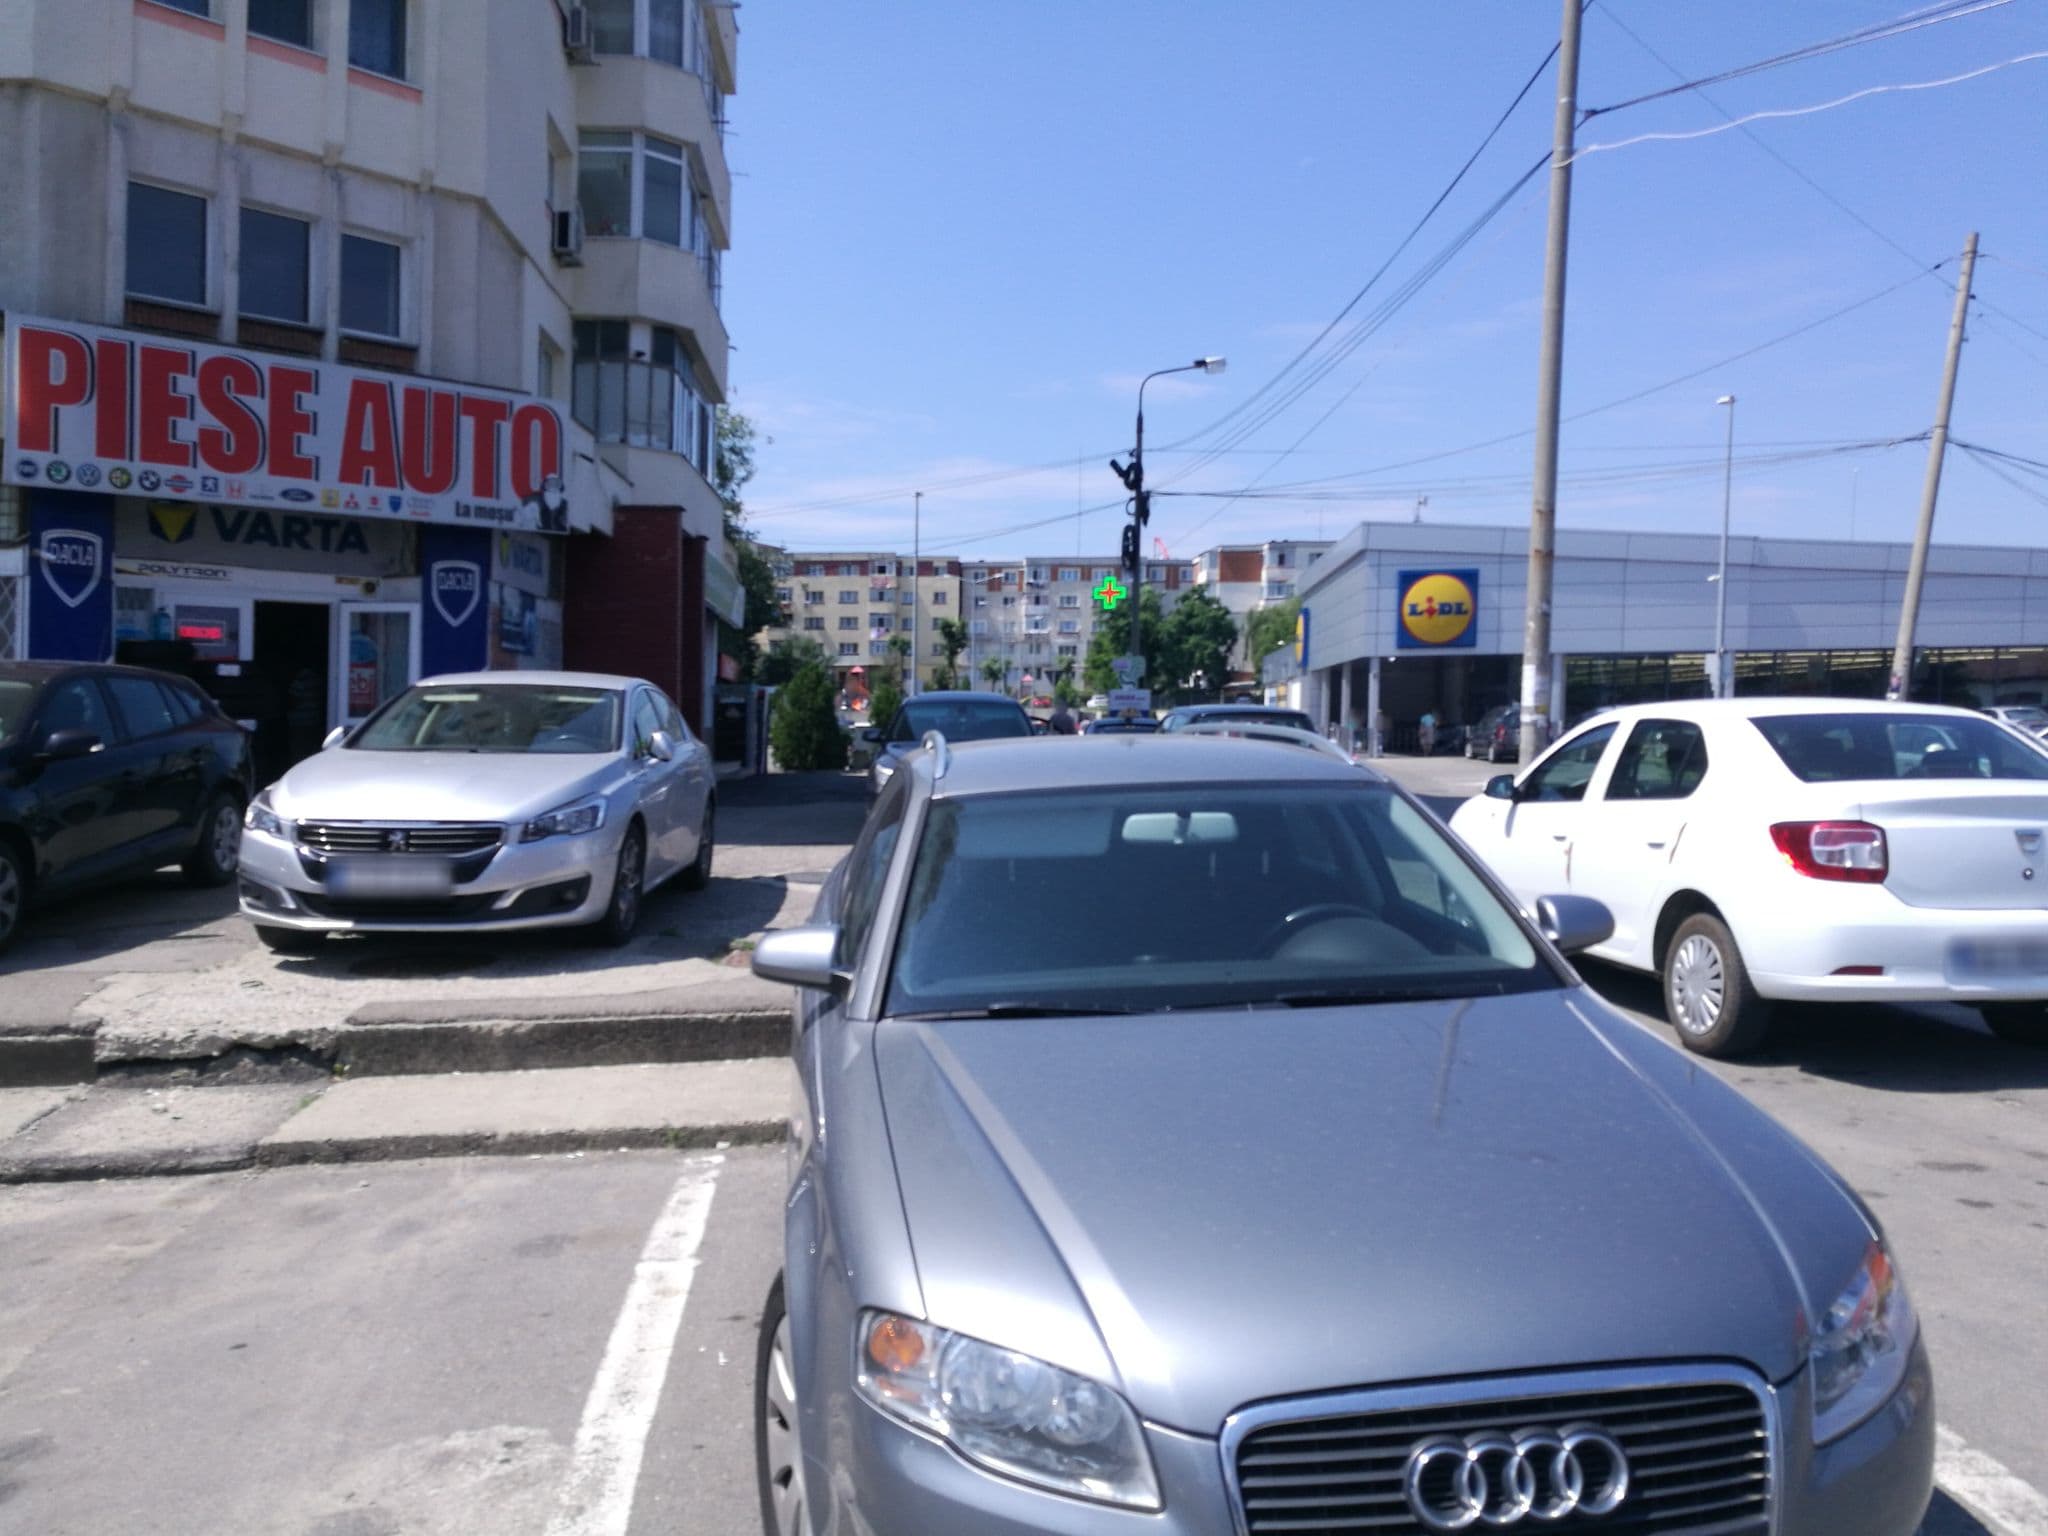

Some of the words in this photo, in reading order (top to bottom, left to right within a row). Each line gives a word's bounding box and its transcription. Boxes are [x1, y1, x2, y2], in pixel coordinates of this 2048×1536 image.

[17, 323, 319, 482] PIESE
[338, 377, 564, 502] AUTO
[49, 542, 95, 566] DACIA
[208, 504, 370, 554] VARTA
